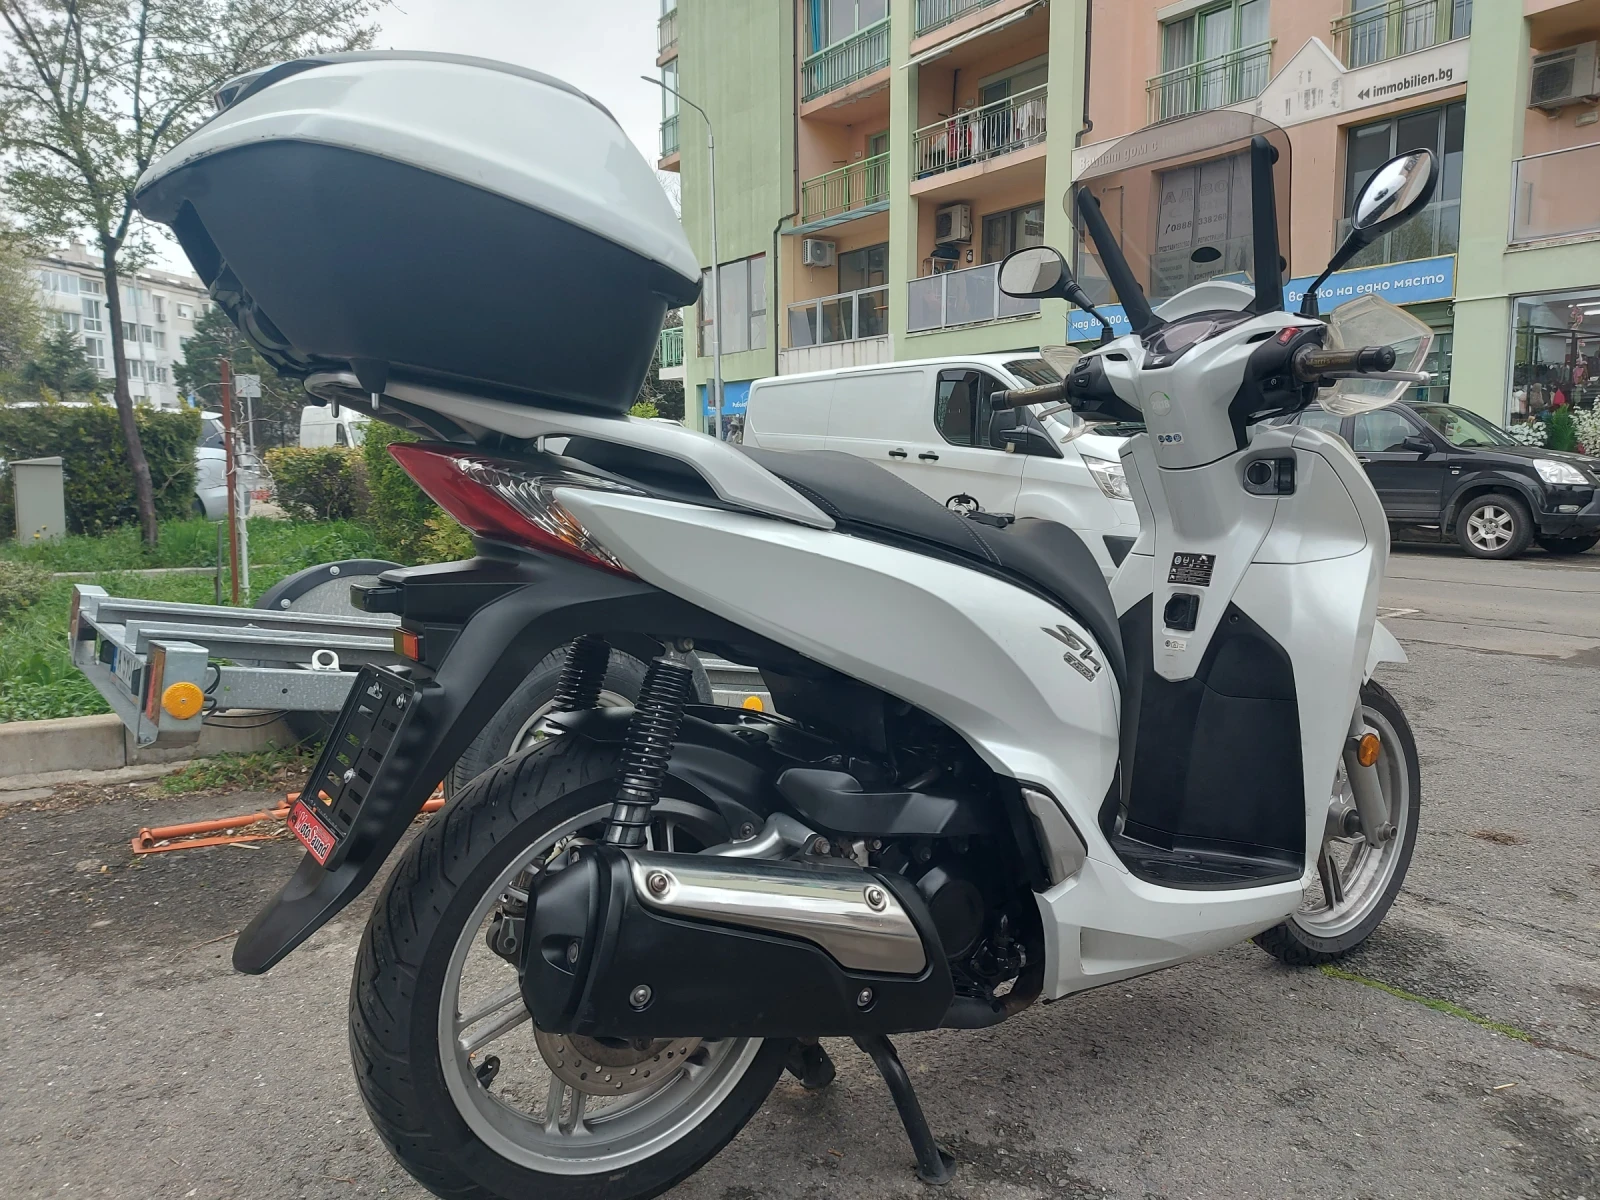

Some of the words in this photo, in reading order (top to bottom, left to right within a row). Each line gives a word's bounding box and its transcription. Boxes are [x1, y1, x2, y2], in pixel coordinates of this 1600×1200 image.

[1373, 68, 1453, 98] immobilien.bg
[1171, 220, 1192, 232] 0888
[1198, 215, 1212, 226] 338
[1336, 285, 1352, 296] на
[1356, 280, 1391, 296] едно
[1394, 274, 1445, 288] място
[1072, 321, 1089, 331] над
